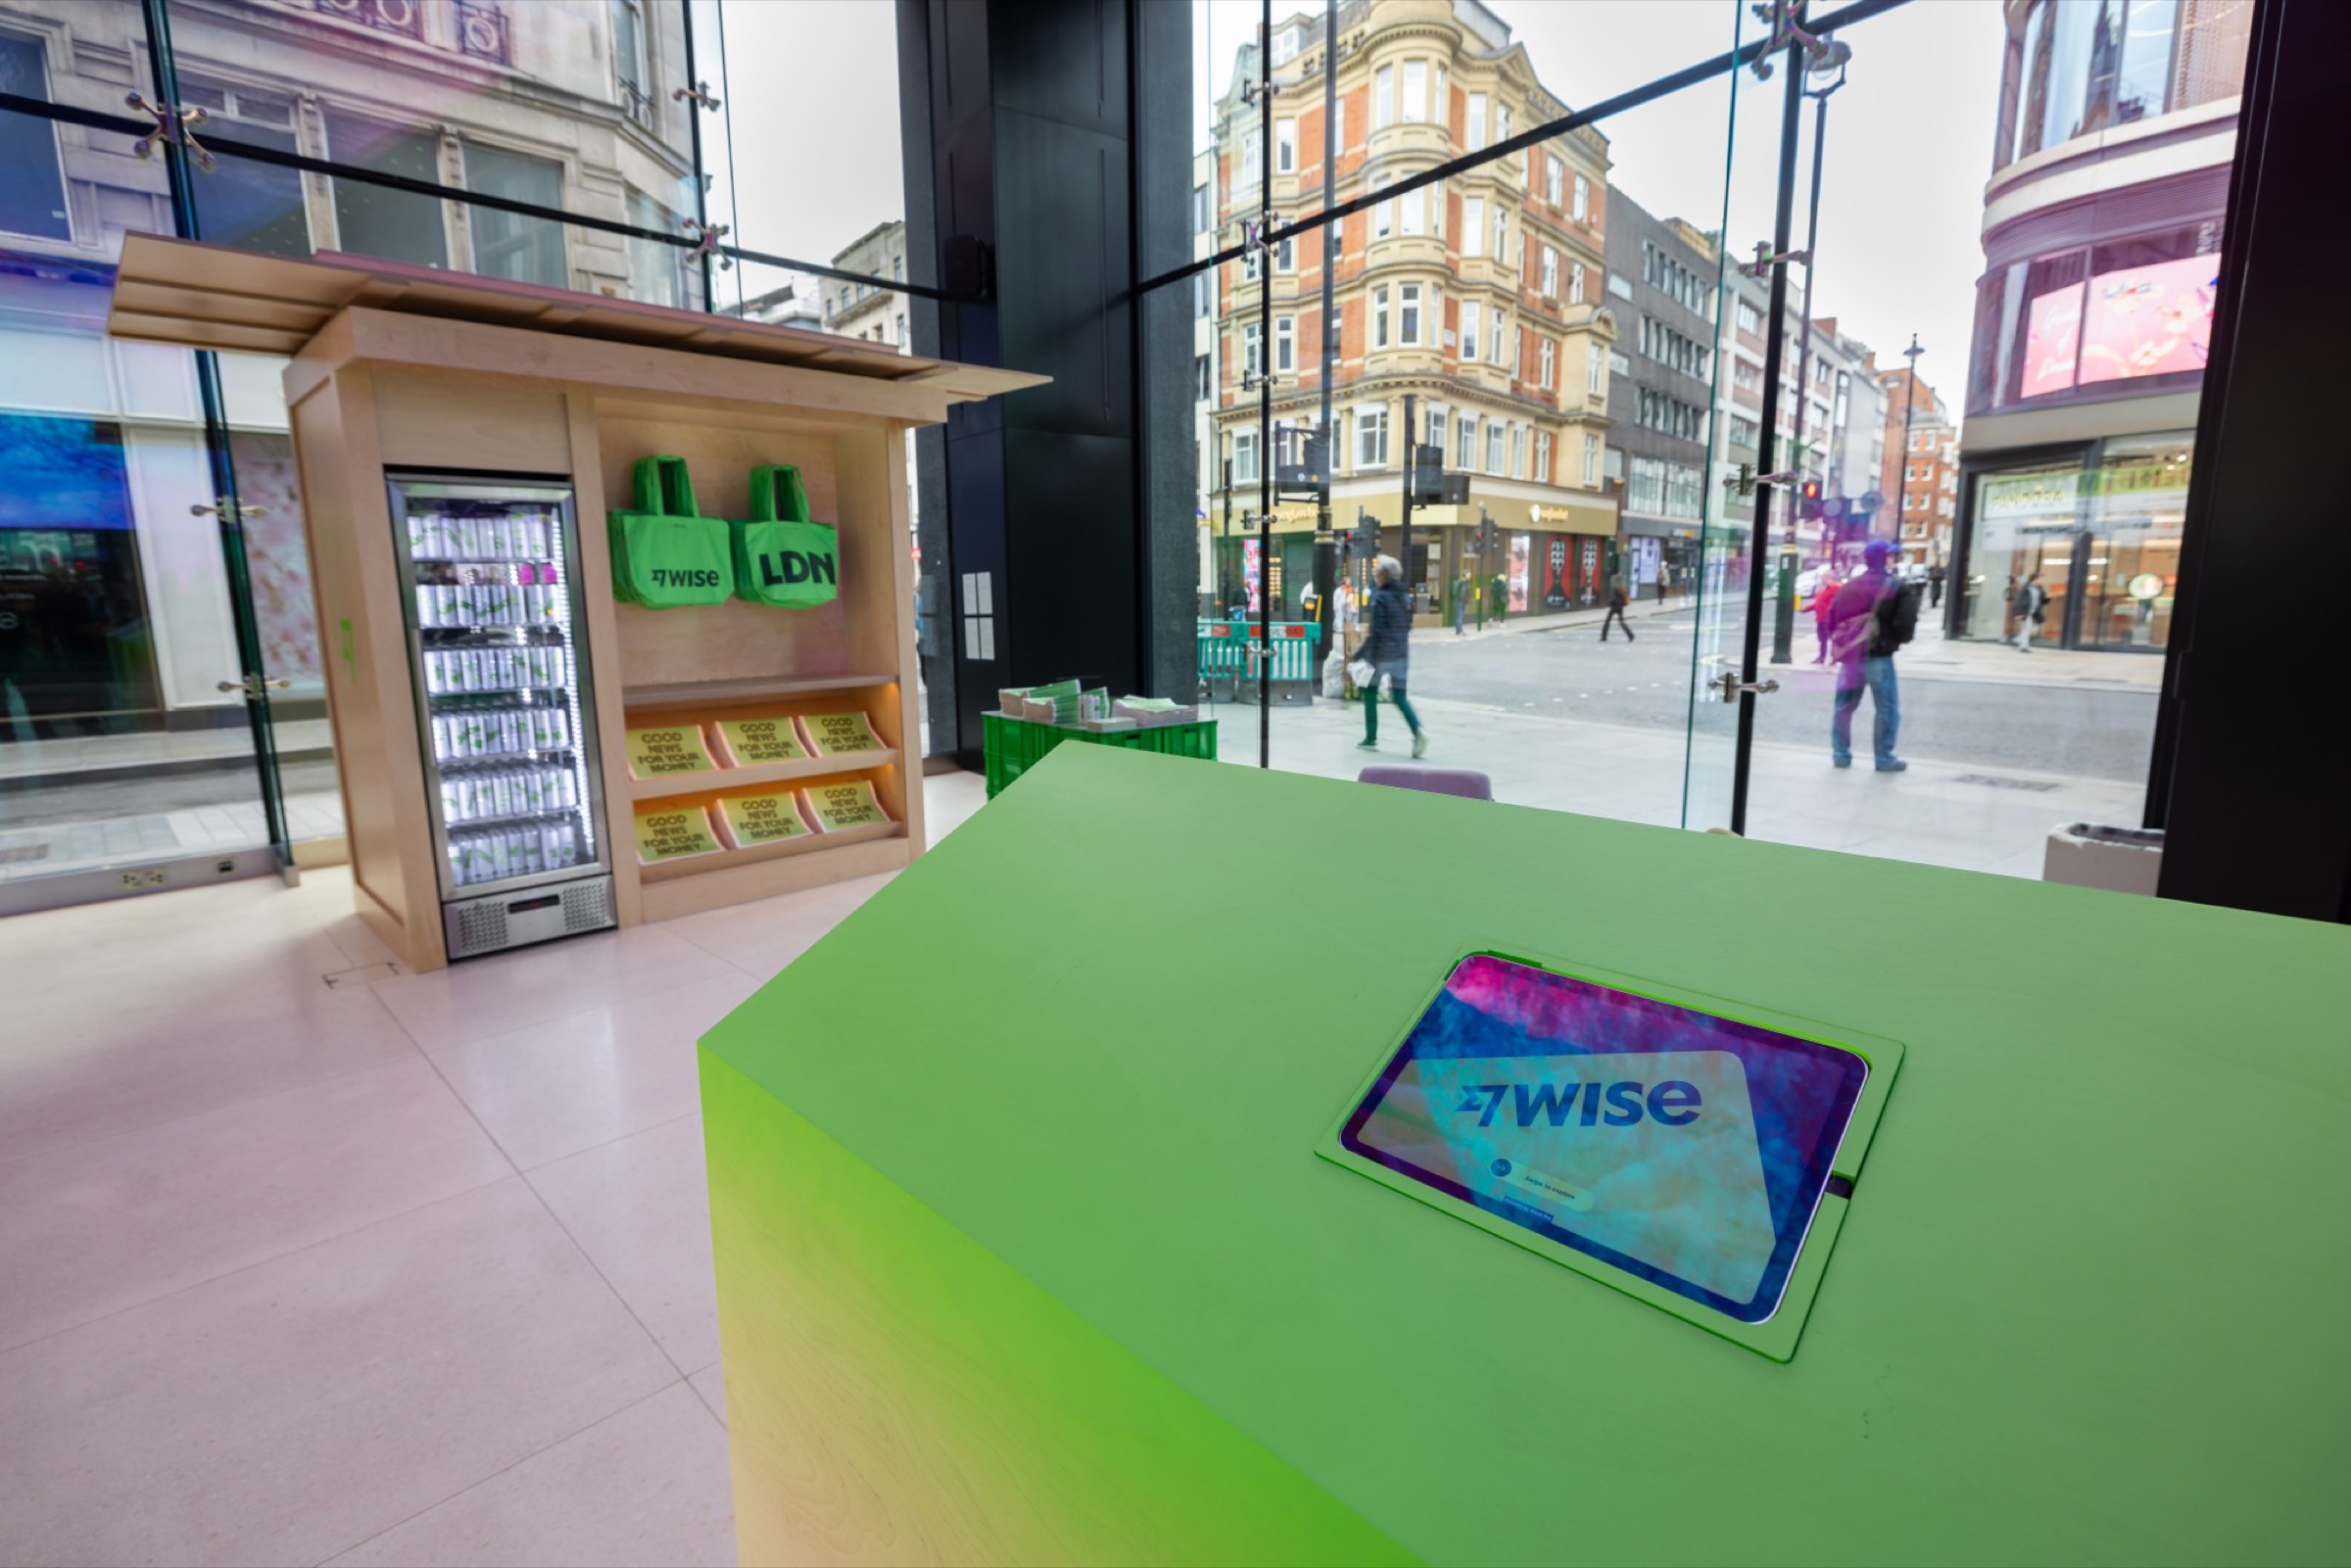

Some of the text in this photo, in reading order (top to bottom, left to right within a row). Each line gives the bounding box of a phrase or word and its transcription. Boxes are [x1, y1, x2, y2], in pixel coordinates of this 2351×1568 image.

[758, 550, 837, 588] LDN
[740, 722, 776, 733] GOOD
[821, 717, 853, 728] GOOD
[642, 733, 683, 743] GOOD
[746, 734, 777, 742] NEWS
[821, 736, 840, 745] FOR
[647, 744, 683, 754] NEWS
[738, 743, 761, 752] FOR
[638, 755, 663, 764] FOR
[825, 787, 857, 799] GOOD
[742, 798, 777, 810] GOOD
[830, 797, 858, 807] NEWS
[746, 810, 778, 820] NEWS
[824, 808, 844, 818] FOR
[647, 815, 687, 828] GOOD
[652, 826, 688, 837] NEWS
[739, 822, 761, 832] FOR
[643, 838, 669, 848] FOR
